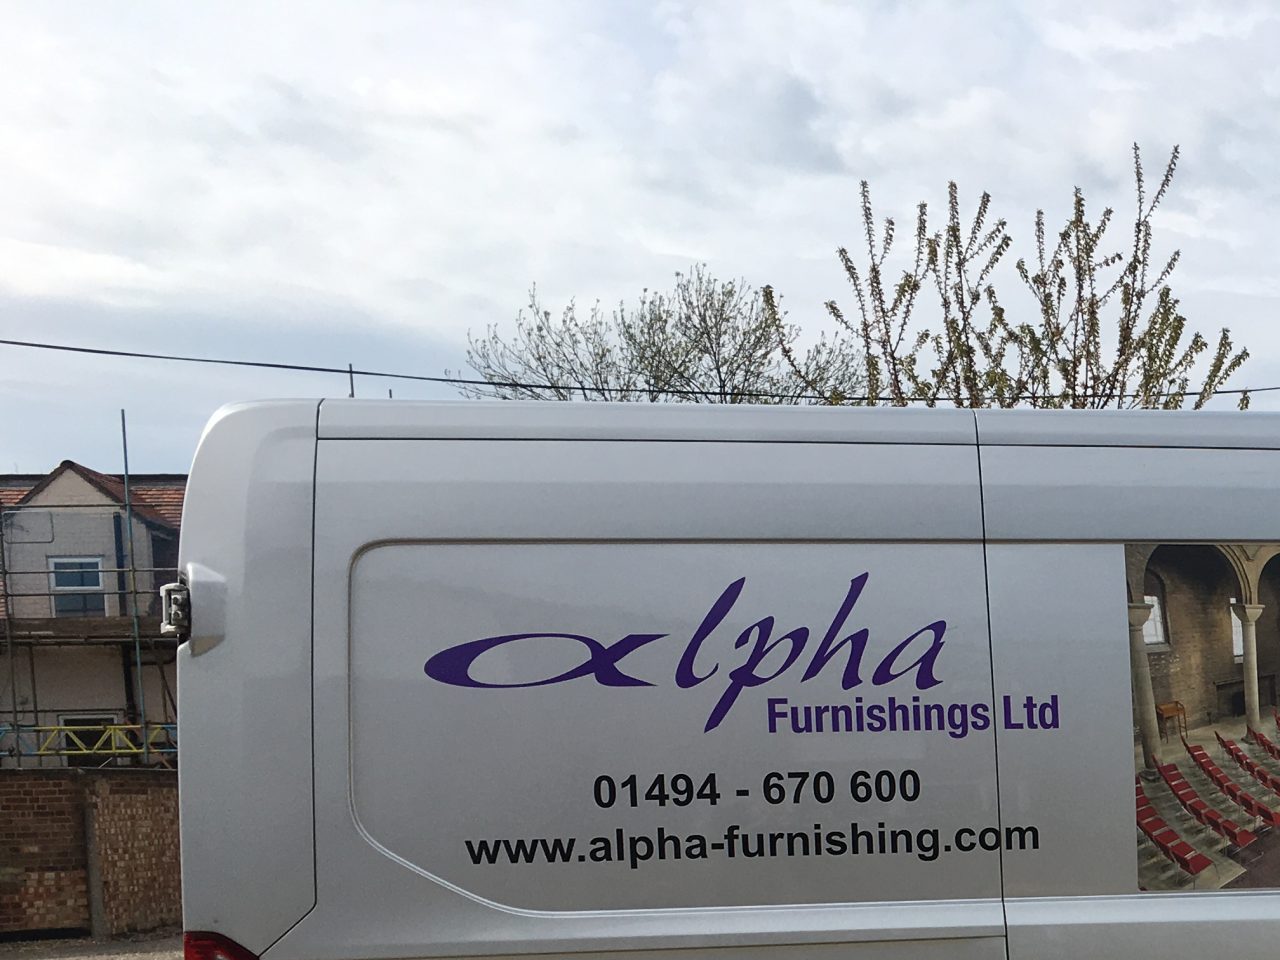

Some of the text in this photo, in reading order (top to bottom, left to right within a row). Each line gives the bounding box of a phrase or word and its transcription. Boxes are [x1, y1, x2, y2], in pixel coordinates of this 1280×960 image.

[767, 695, 1060, 740] Furnishings Ltd
[593, 772, 721, 808] 01494
[762, 771, 835, 804] 670
[850, 769, 921, 803] 600
[464, 821, 1041, 869] www.alpha-furnishing.com
